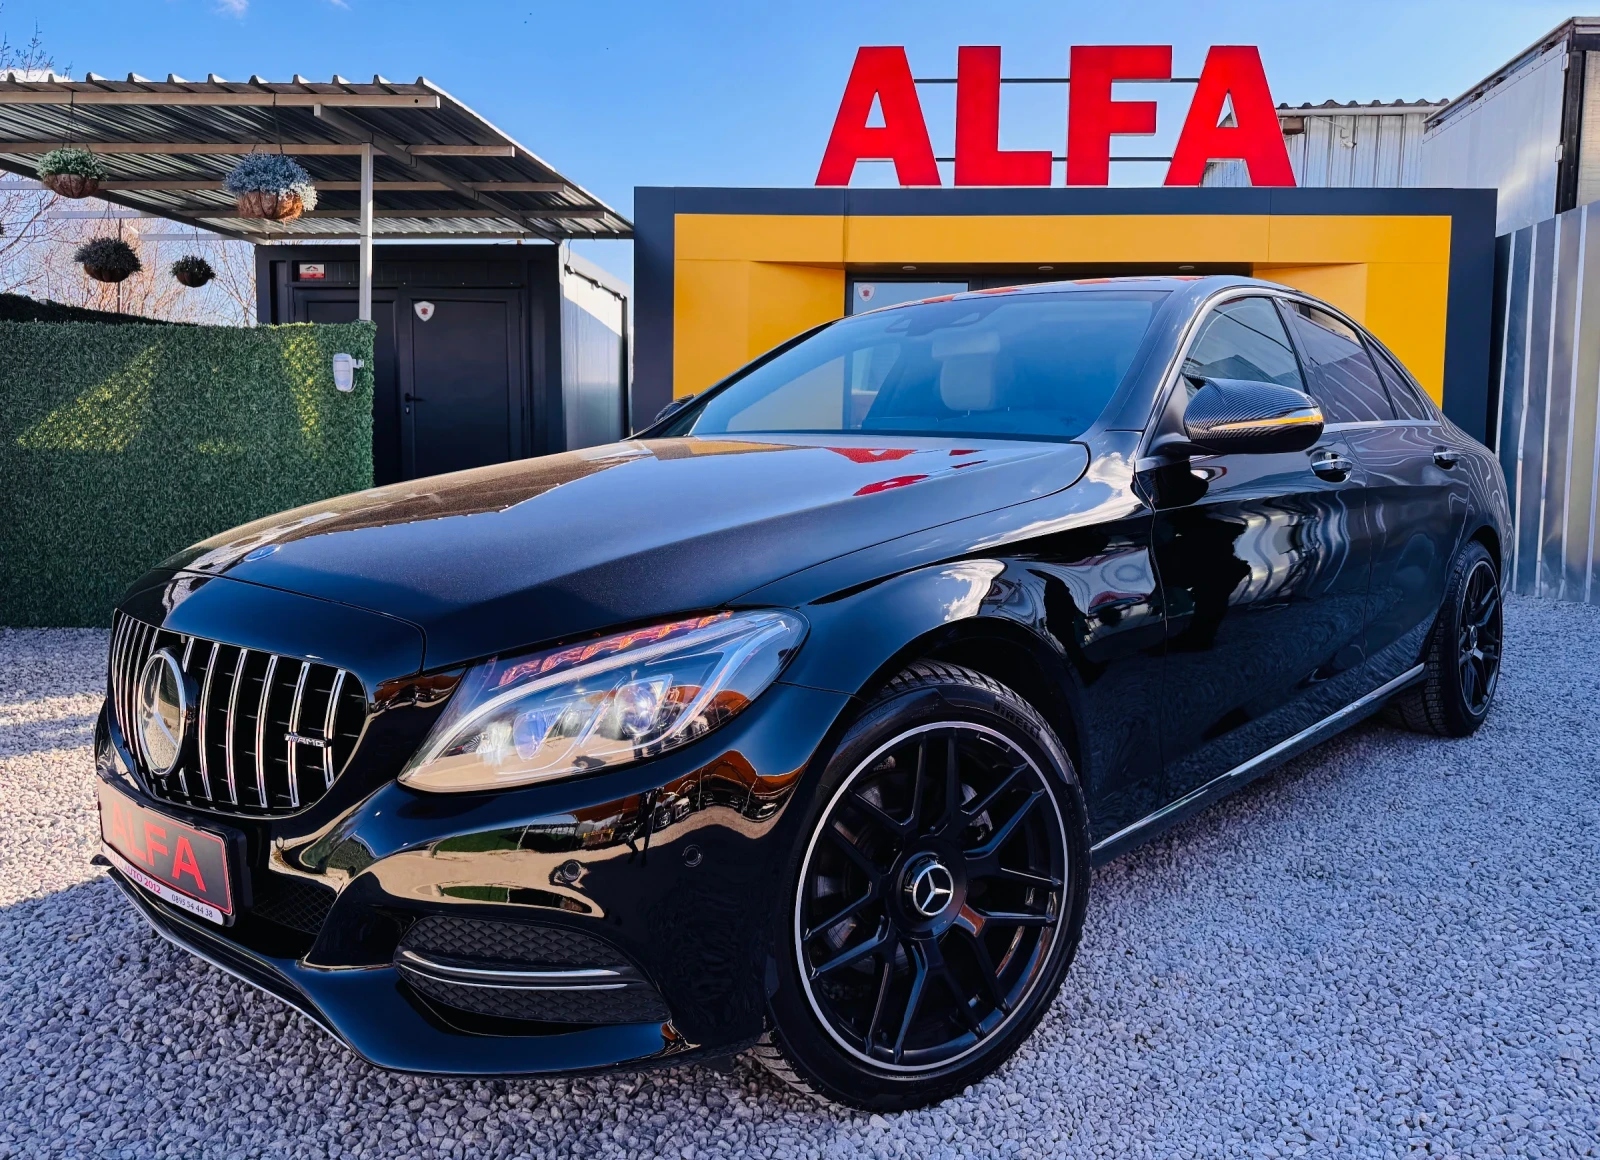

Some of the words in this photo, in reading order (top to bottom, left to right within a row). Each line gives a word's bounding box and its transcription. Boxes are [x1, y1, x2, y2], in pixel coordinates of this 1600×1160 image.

[815, 45, 1296, 187] ALFA
[994, 701, 1040, 740] PIRELLI
[112, 801, 206, 892] ALFA
[124, 864, 143, 882] AUTO
[144, 877, 161, 894] 2012
[171, 893, 186, 906] 0895
[186, 901, 195, 910] 54
[195, 905, 204, 915] 44
[205, 908, 213, 918] 38
